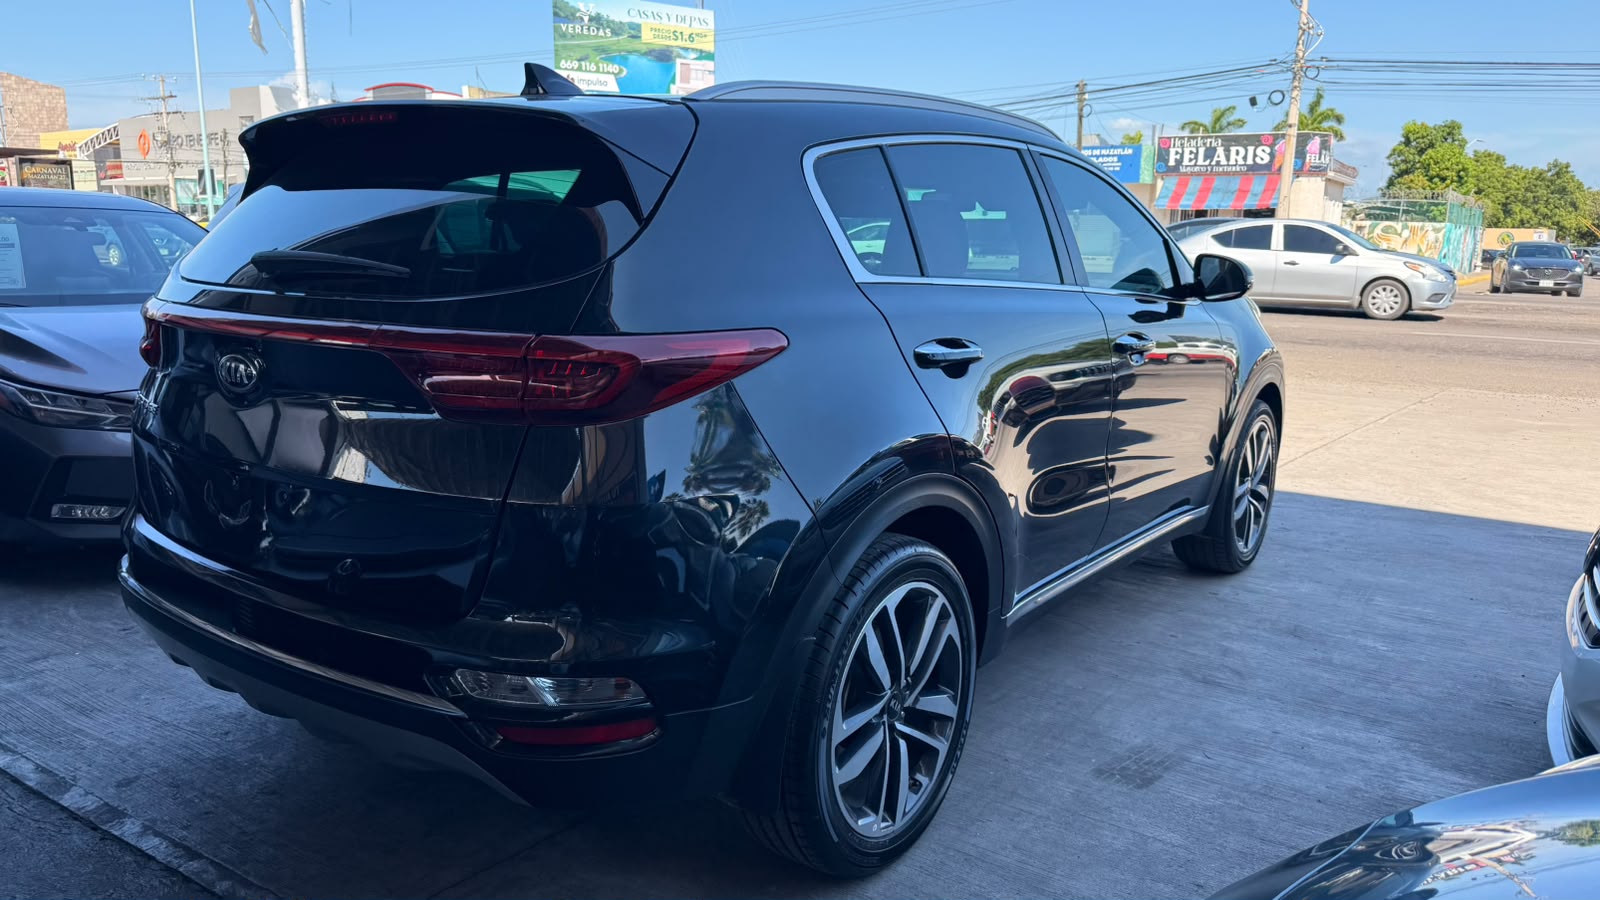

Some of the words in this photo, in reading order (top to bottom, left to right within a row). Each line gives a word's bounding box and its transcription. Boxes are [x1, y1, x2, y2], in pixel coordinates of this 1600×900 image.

[627, 8, 663, 21] CASAS
[665, 12, 673, 23] Y
[675, 14, 709, 28] DEPAS
[560, 23, 612, 37] VEREDAS
[650, 27, 672, 35] PRECIO
[653, 33, 672, 41] DESDE
[560, 59, 579, 70] 669
[581, 61, 597, 72] 116
[598, 63, 620, 74] 1140
[577, 76, 608, 88] impulsa
[1093, 148, 1101, 156] DE
[1168, 145, 1271, 166] FELARIS
[24, 165, 65, 175] CARNAVAL
[221, 361, 249, 384] KIA
